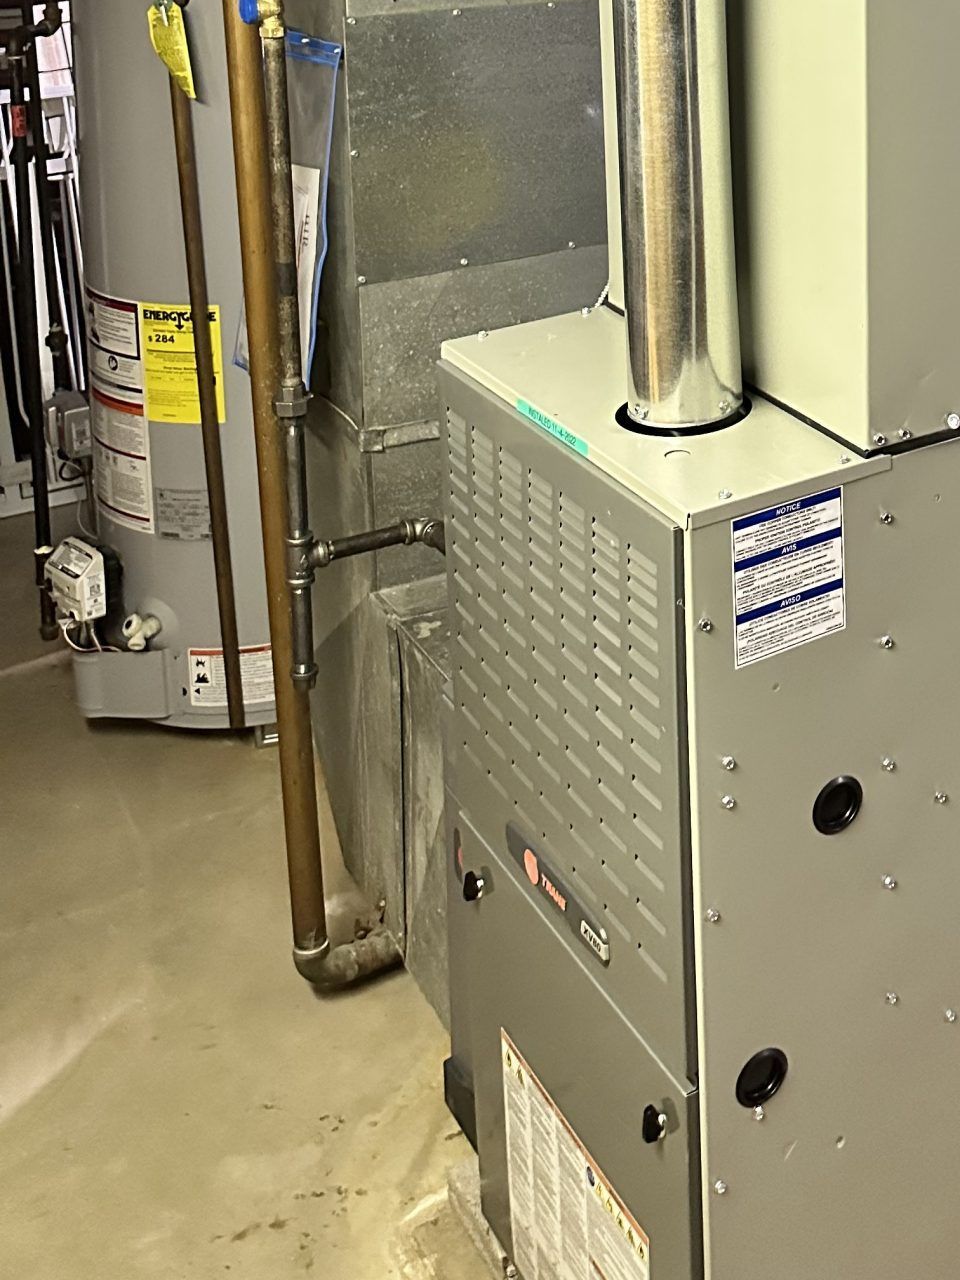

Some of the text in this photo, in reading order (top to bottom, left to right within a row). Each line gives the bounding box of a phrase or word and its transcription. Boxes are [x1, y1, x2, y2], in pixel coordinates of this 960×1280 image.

[155, 333, 176, 344] 284
[775, 501, 801, 517] NOTICE
[781, 543, 797, 555] AVIS
[780, 594, 801, 608] AVISO
